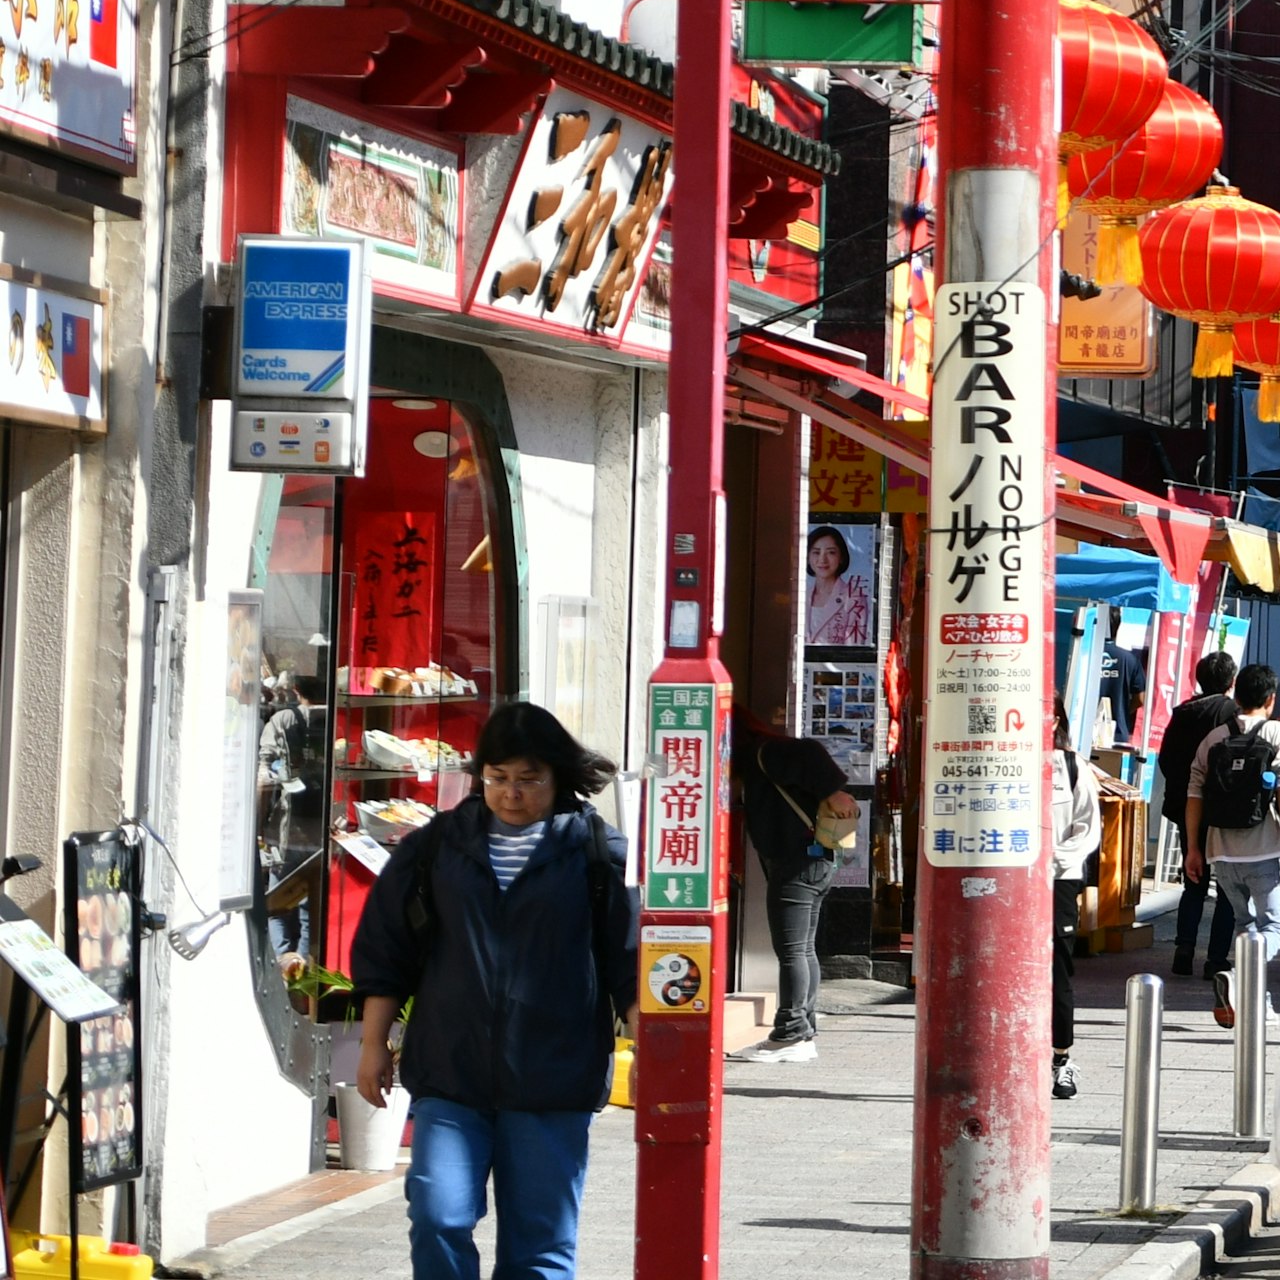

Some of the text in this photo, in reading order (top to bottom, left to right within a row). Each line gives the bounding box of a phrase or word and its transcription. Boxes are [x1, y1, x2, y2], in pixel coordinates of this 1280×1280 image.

[244, 281, 343, 299] AMERICAN
[265, 302, 348, 320] EXPRESS
[948, 290, 1026, 316] SHOT
[1064, 324, 1138, 341] 関帝廟通り
[242, 353, 287, 369] Cards
[242, 367, 311, 382] Welcome
[954, 320, 1016, 445] BAR
[947, 453, 989, 605] ノルゲ
[1000, 454, 1024, 602] NORGE
[846, 574, 870, 644] 佐々木
[944, 615, 1025, 629] 二次会・女子会
[945, 648, 1022, 664] ノーチャージ
[655, 689, 711, 707] 三国志
[941, 765, 1024, 778] 045-641-7020
[656, 735, 703, 868] 関帝廟
[968, 797, 1032, 813] 地図と案内
[932, 827, 1030, 854] 車に注意
